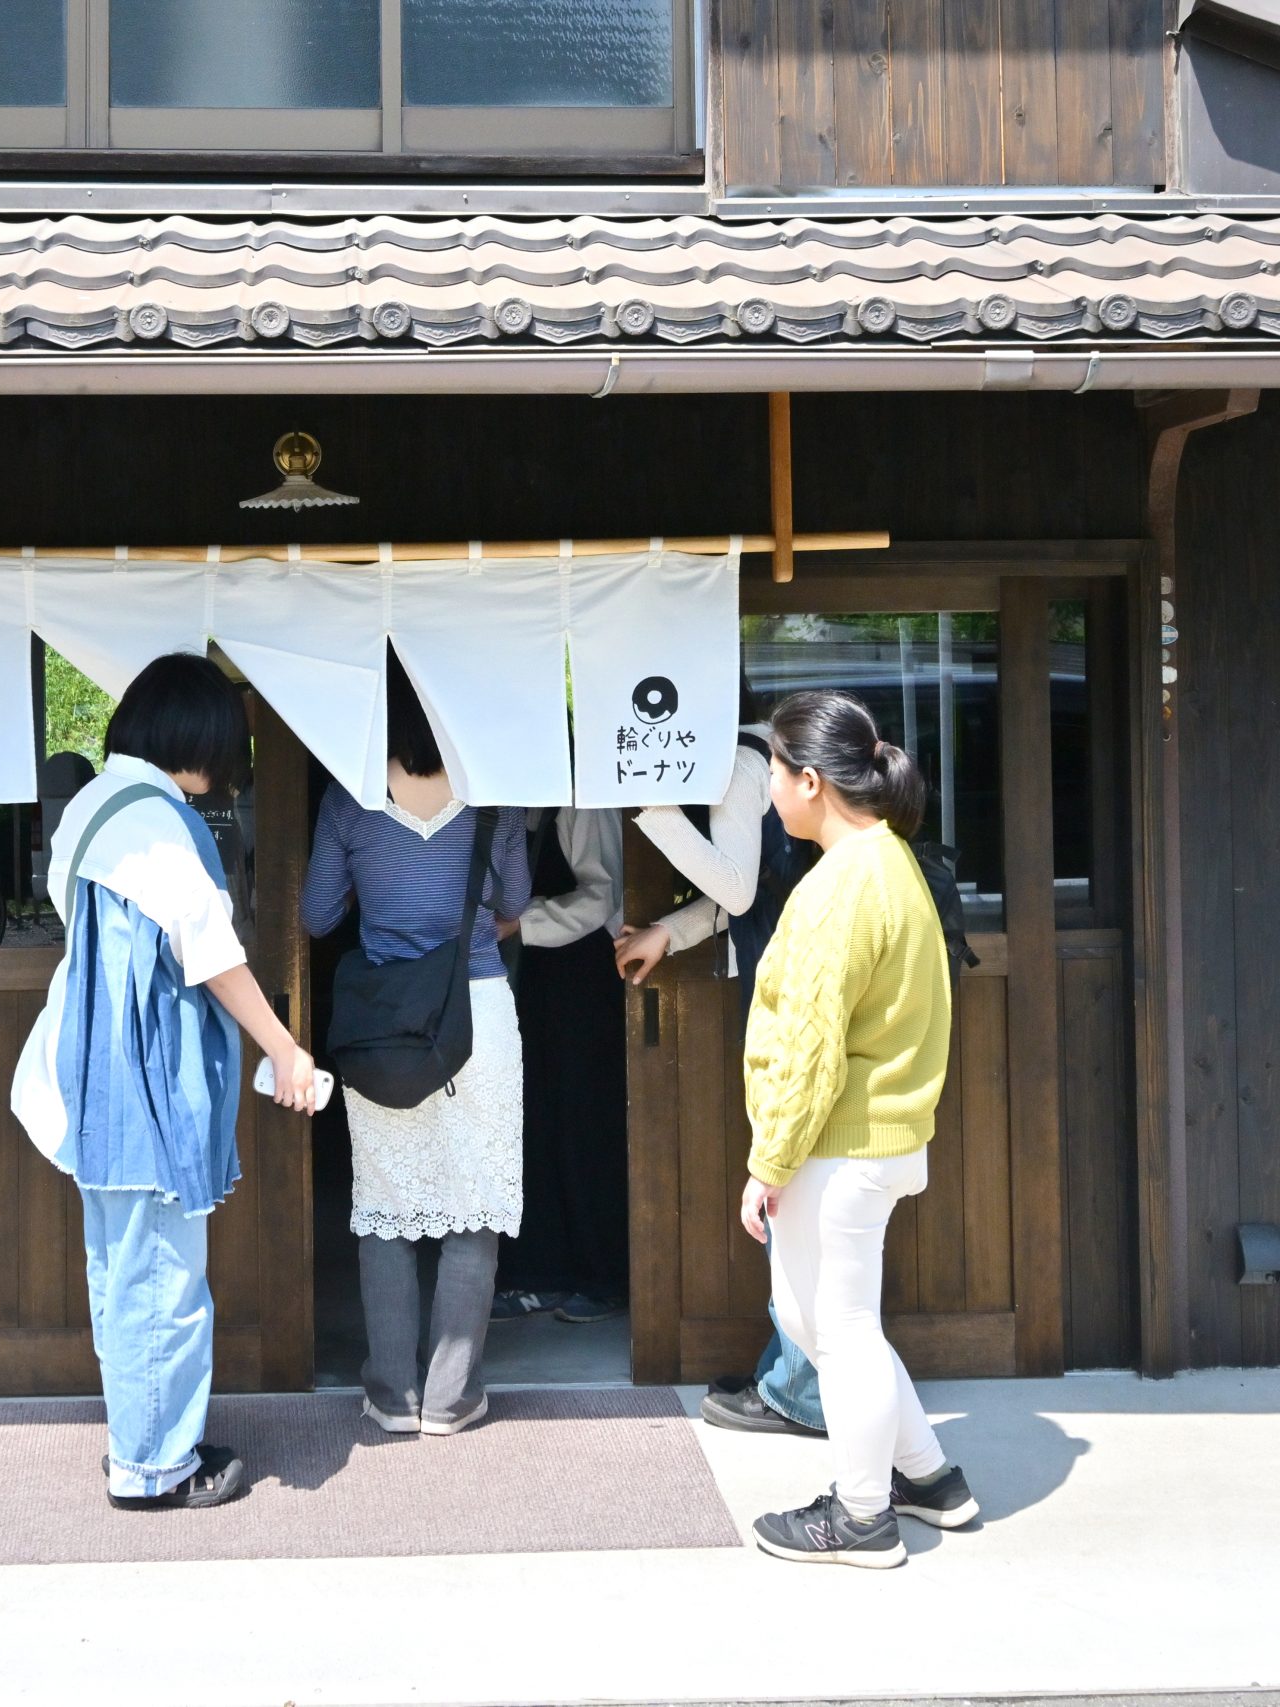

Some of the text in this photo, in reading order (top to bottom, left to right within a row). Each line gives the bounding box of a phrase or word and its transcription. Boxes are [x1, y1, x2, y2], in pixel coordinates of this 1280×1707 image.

[617, 726, 696, 754] 輪ぐりや
[617, 760, 695, 784] ドーナツ
[520, 1294, 541, 1311] N
[805, 1520, 843, 1549] N
